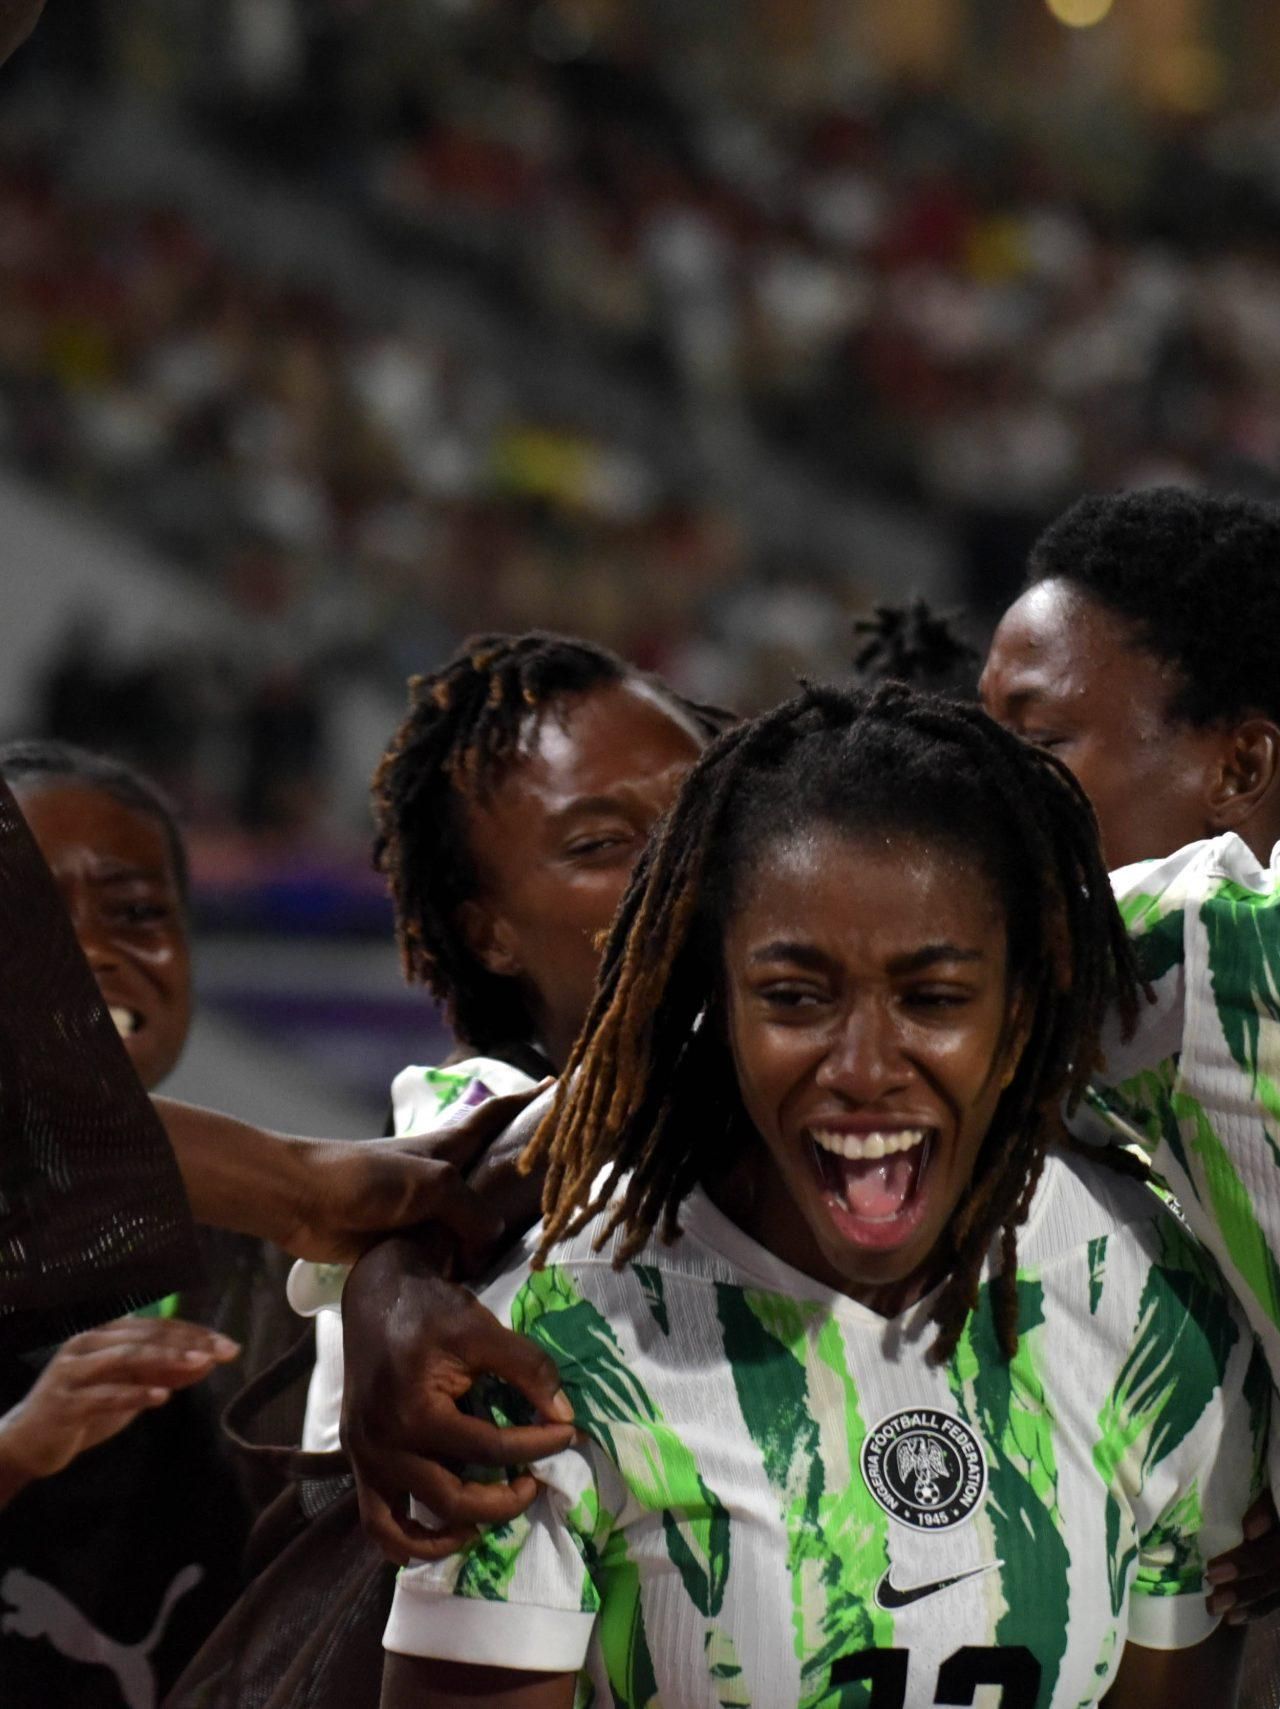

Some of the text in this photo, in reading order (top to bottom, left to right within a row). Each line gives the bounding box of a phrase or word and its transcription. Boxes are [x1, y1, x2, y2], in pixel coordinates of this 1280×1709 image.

[867, 1413, 981, 1511] NIGERIA FOOTBALL FEDERATION
[917, 1512, 949, 1526] 1945
